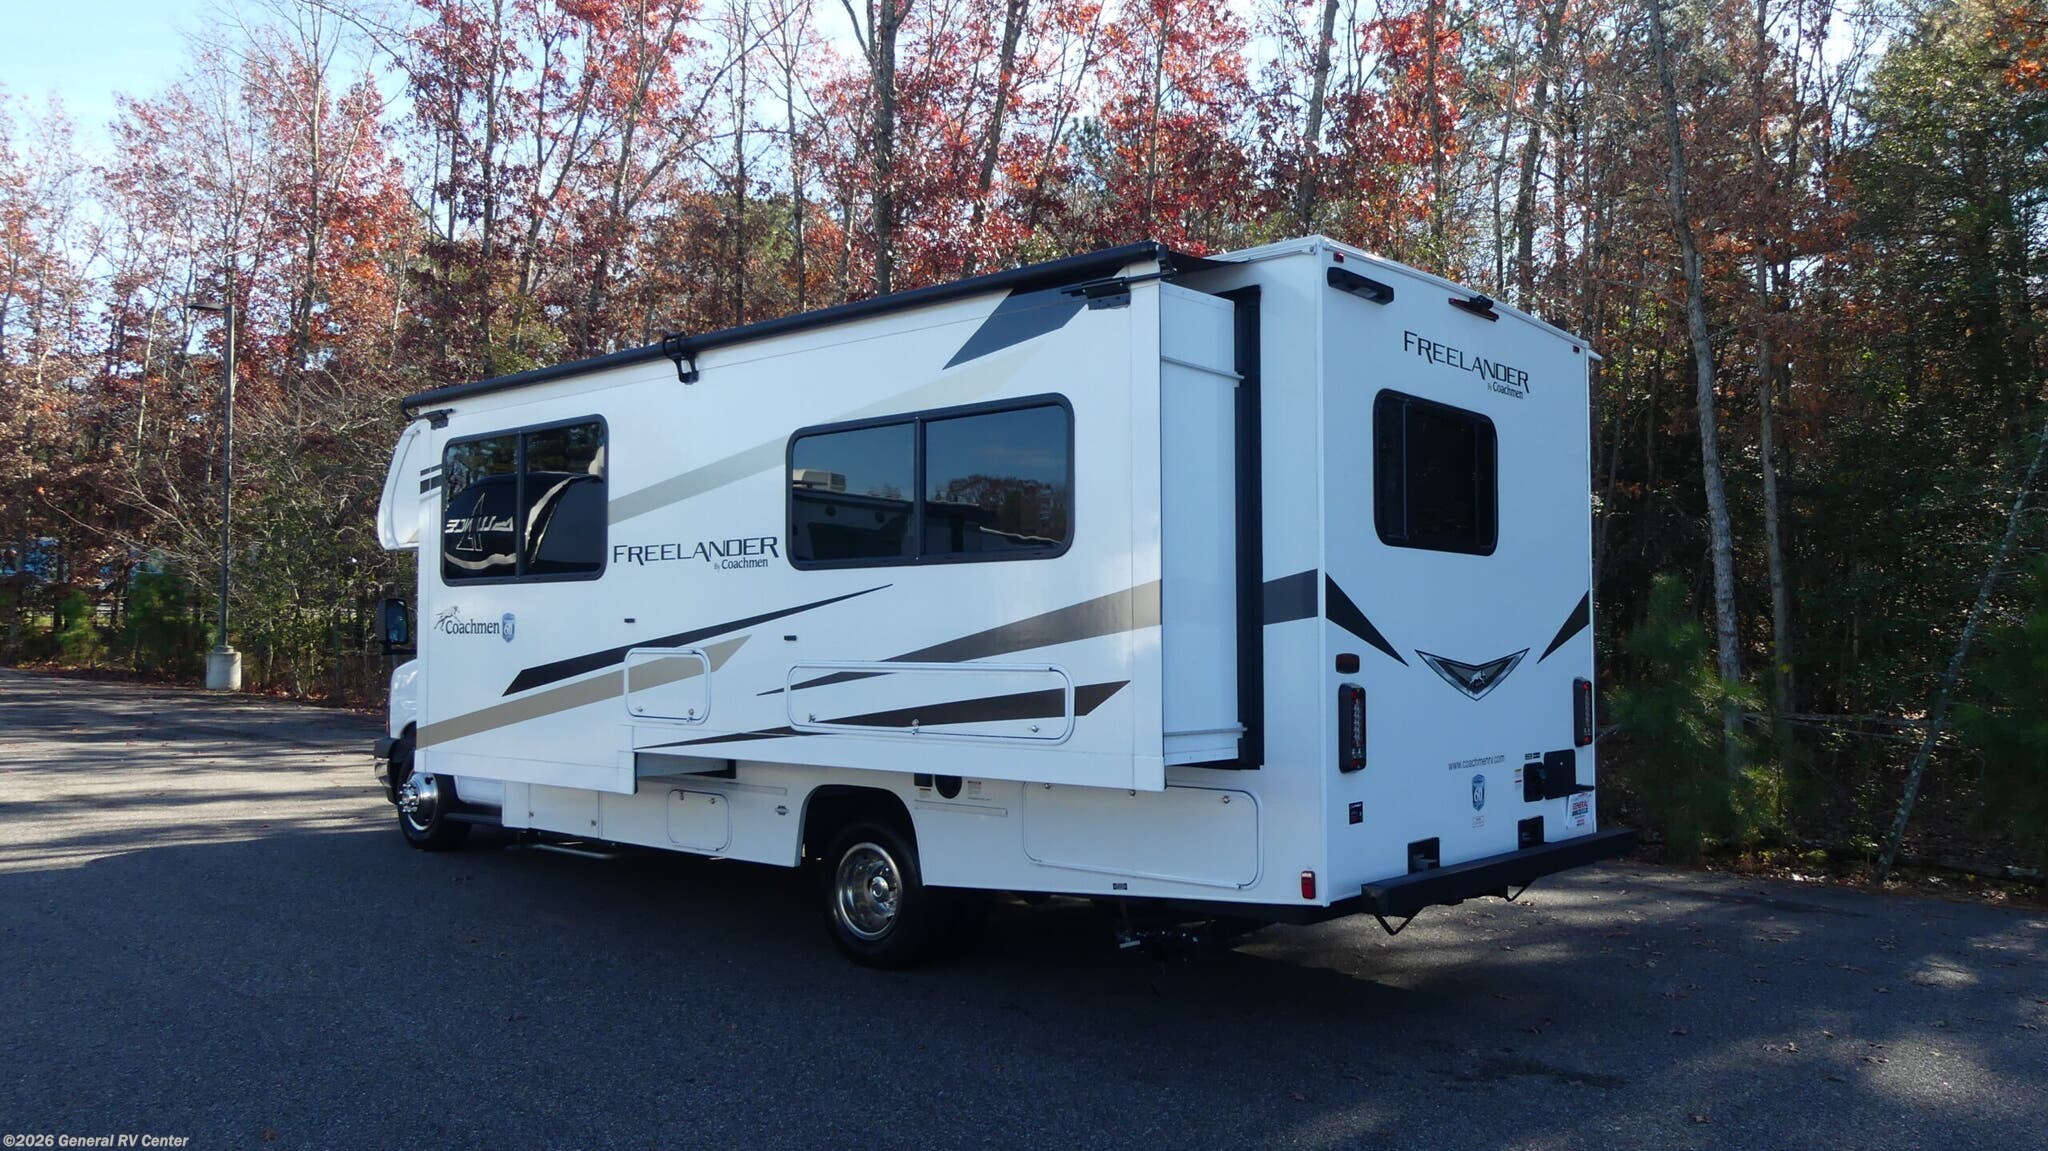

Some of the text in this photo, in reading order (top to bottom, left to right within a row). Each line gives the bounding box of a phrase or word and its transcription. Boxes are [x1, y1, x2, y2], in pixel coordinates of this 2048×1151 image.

[1404, 330, 1530, 393] FREELANDER
[1493, 381, 1523, 399] Coachmen
[613, 536, 779, 566] FREELANDER
[721, 557, 769, 570] Coachmen
[445, 618, 500, 634] Coachmen
